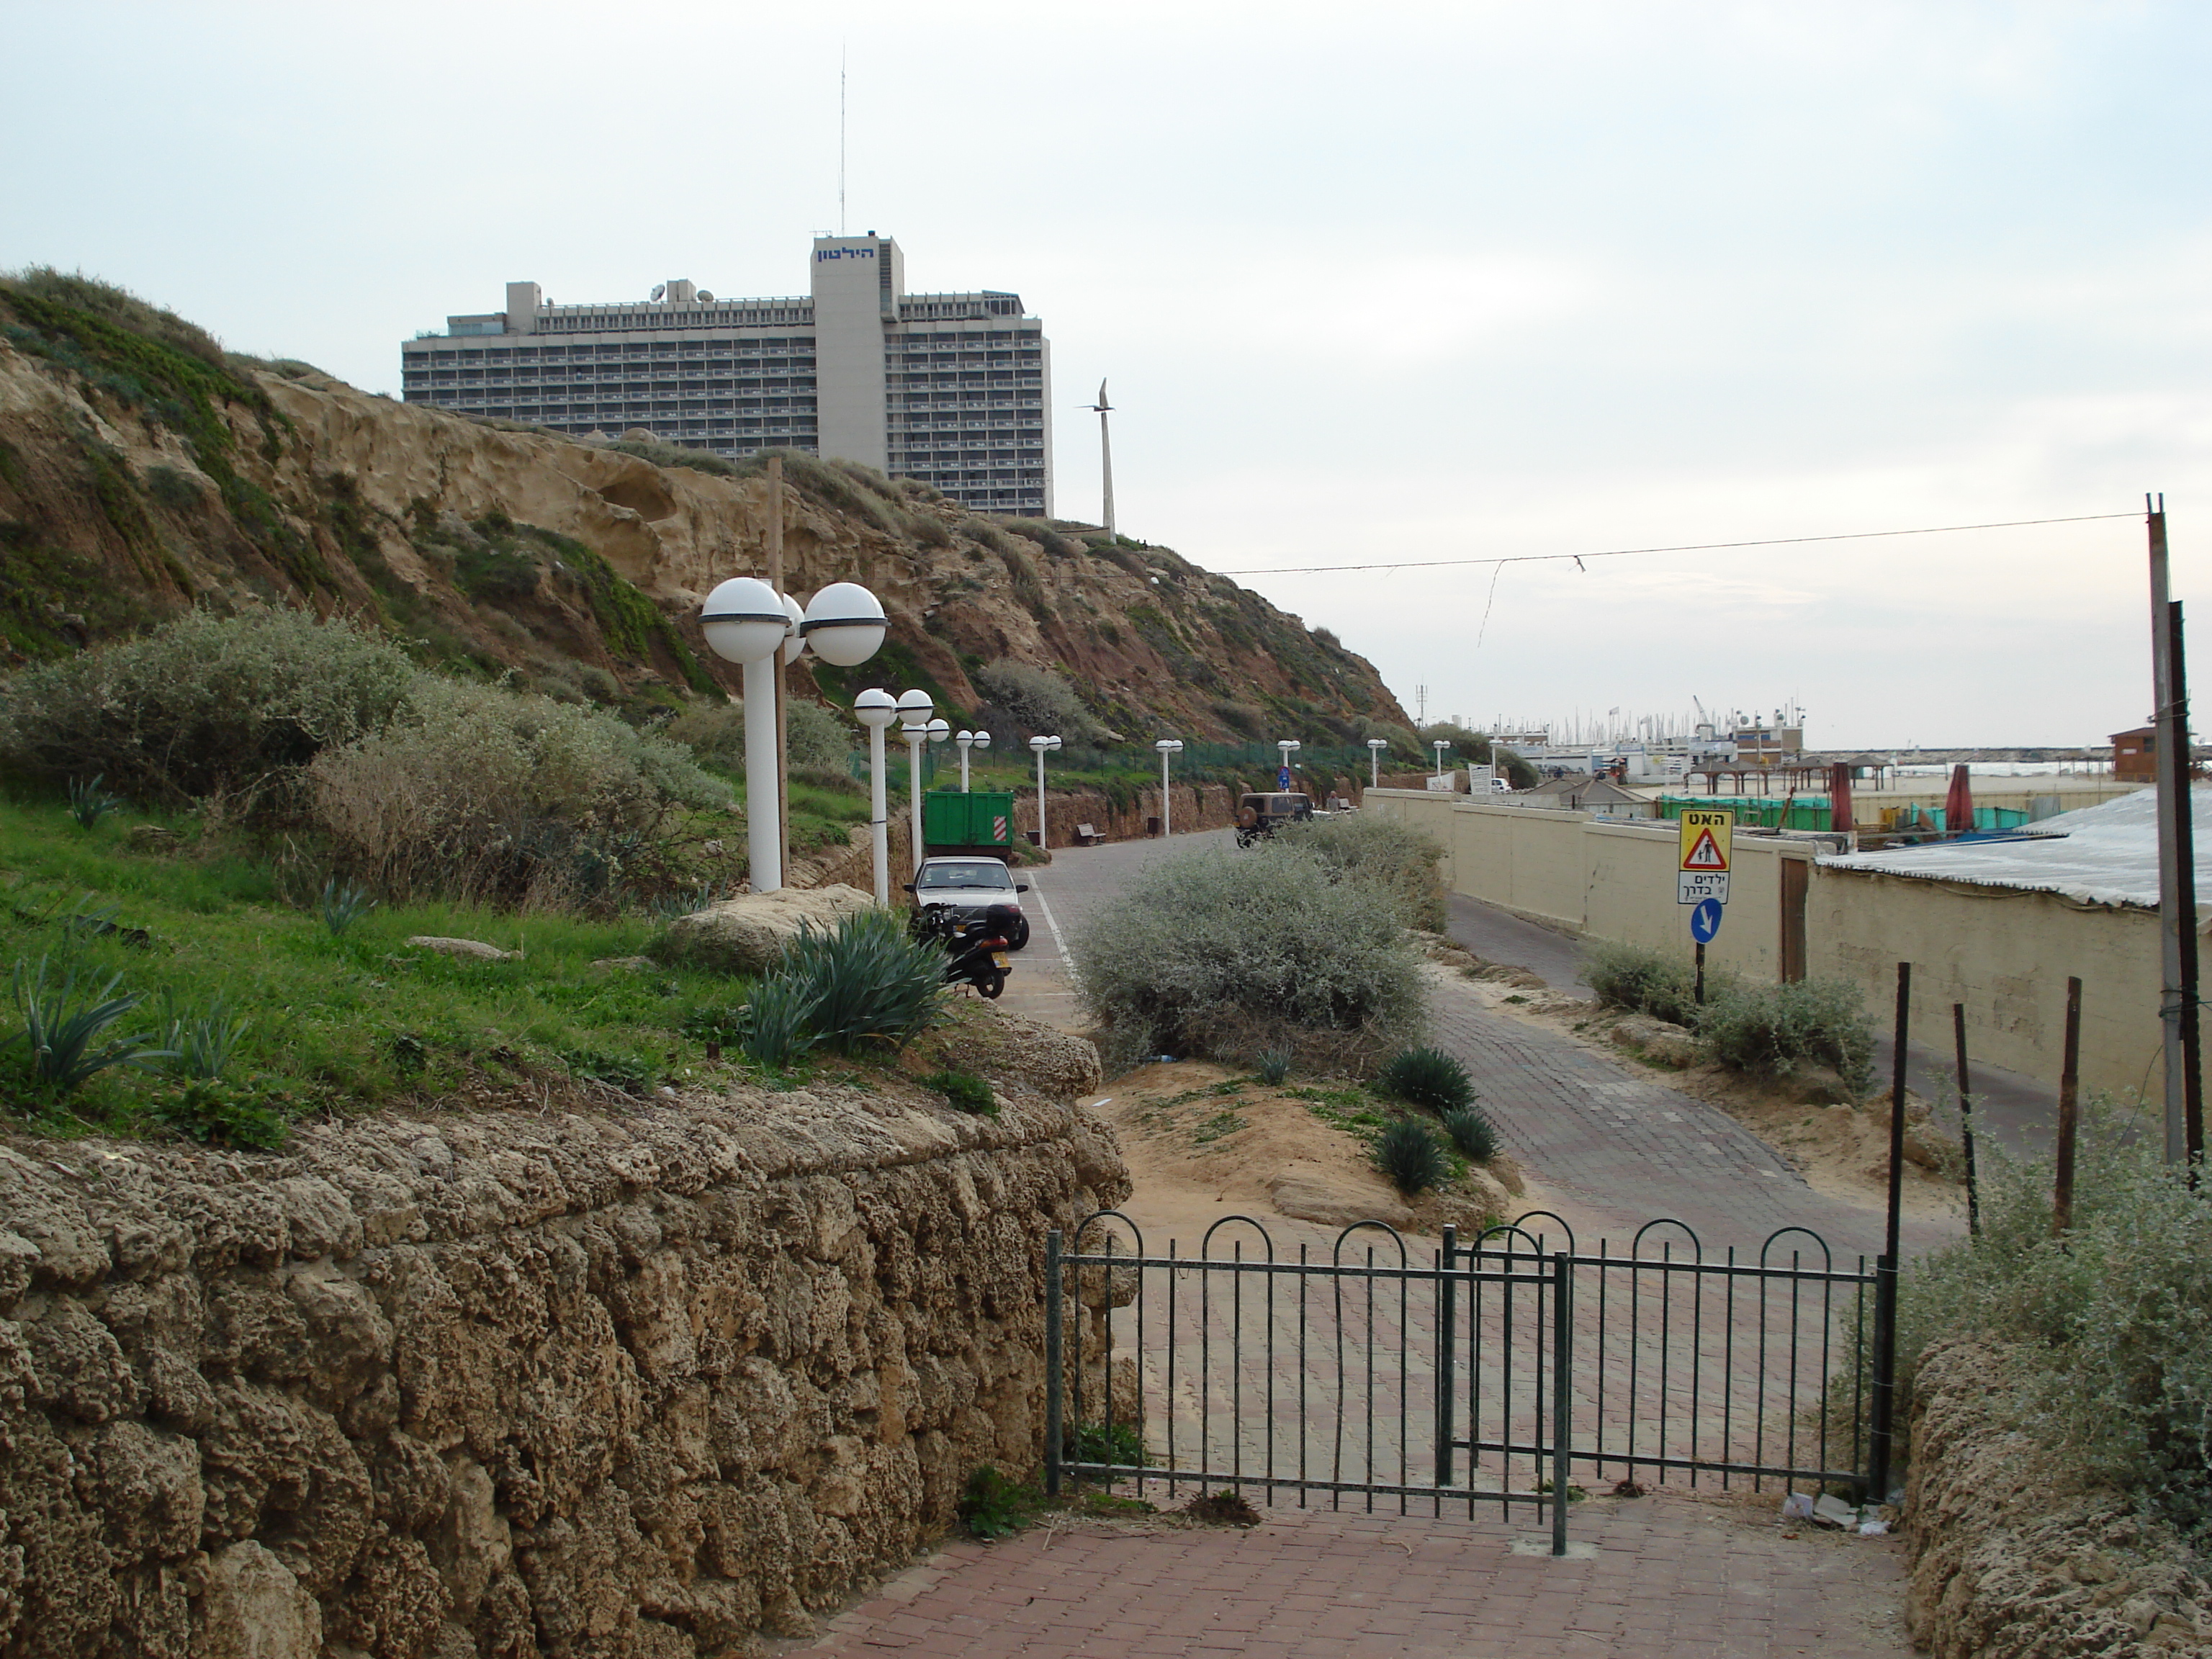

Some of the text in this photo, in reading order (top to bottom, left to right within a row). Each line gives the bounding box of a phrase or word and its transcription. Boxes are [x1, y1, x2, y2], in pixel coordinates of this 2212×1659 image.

[818, 247, 874, 262] הילטון
[1689, 814, 1725, 825] האט
[1695, 873, 1725, 884] ילדים
[1683, 886, 1712, 896] בדרך
